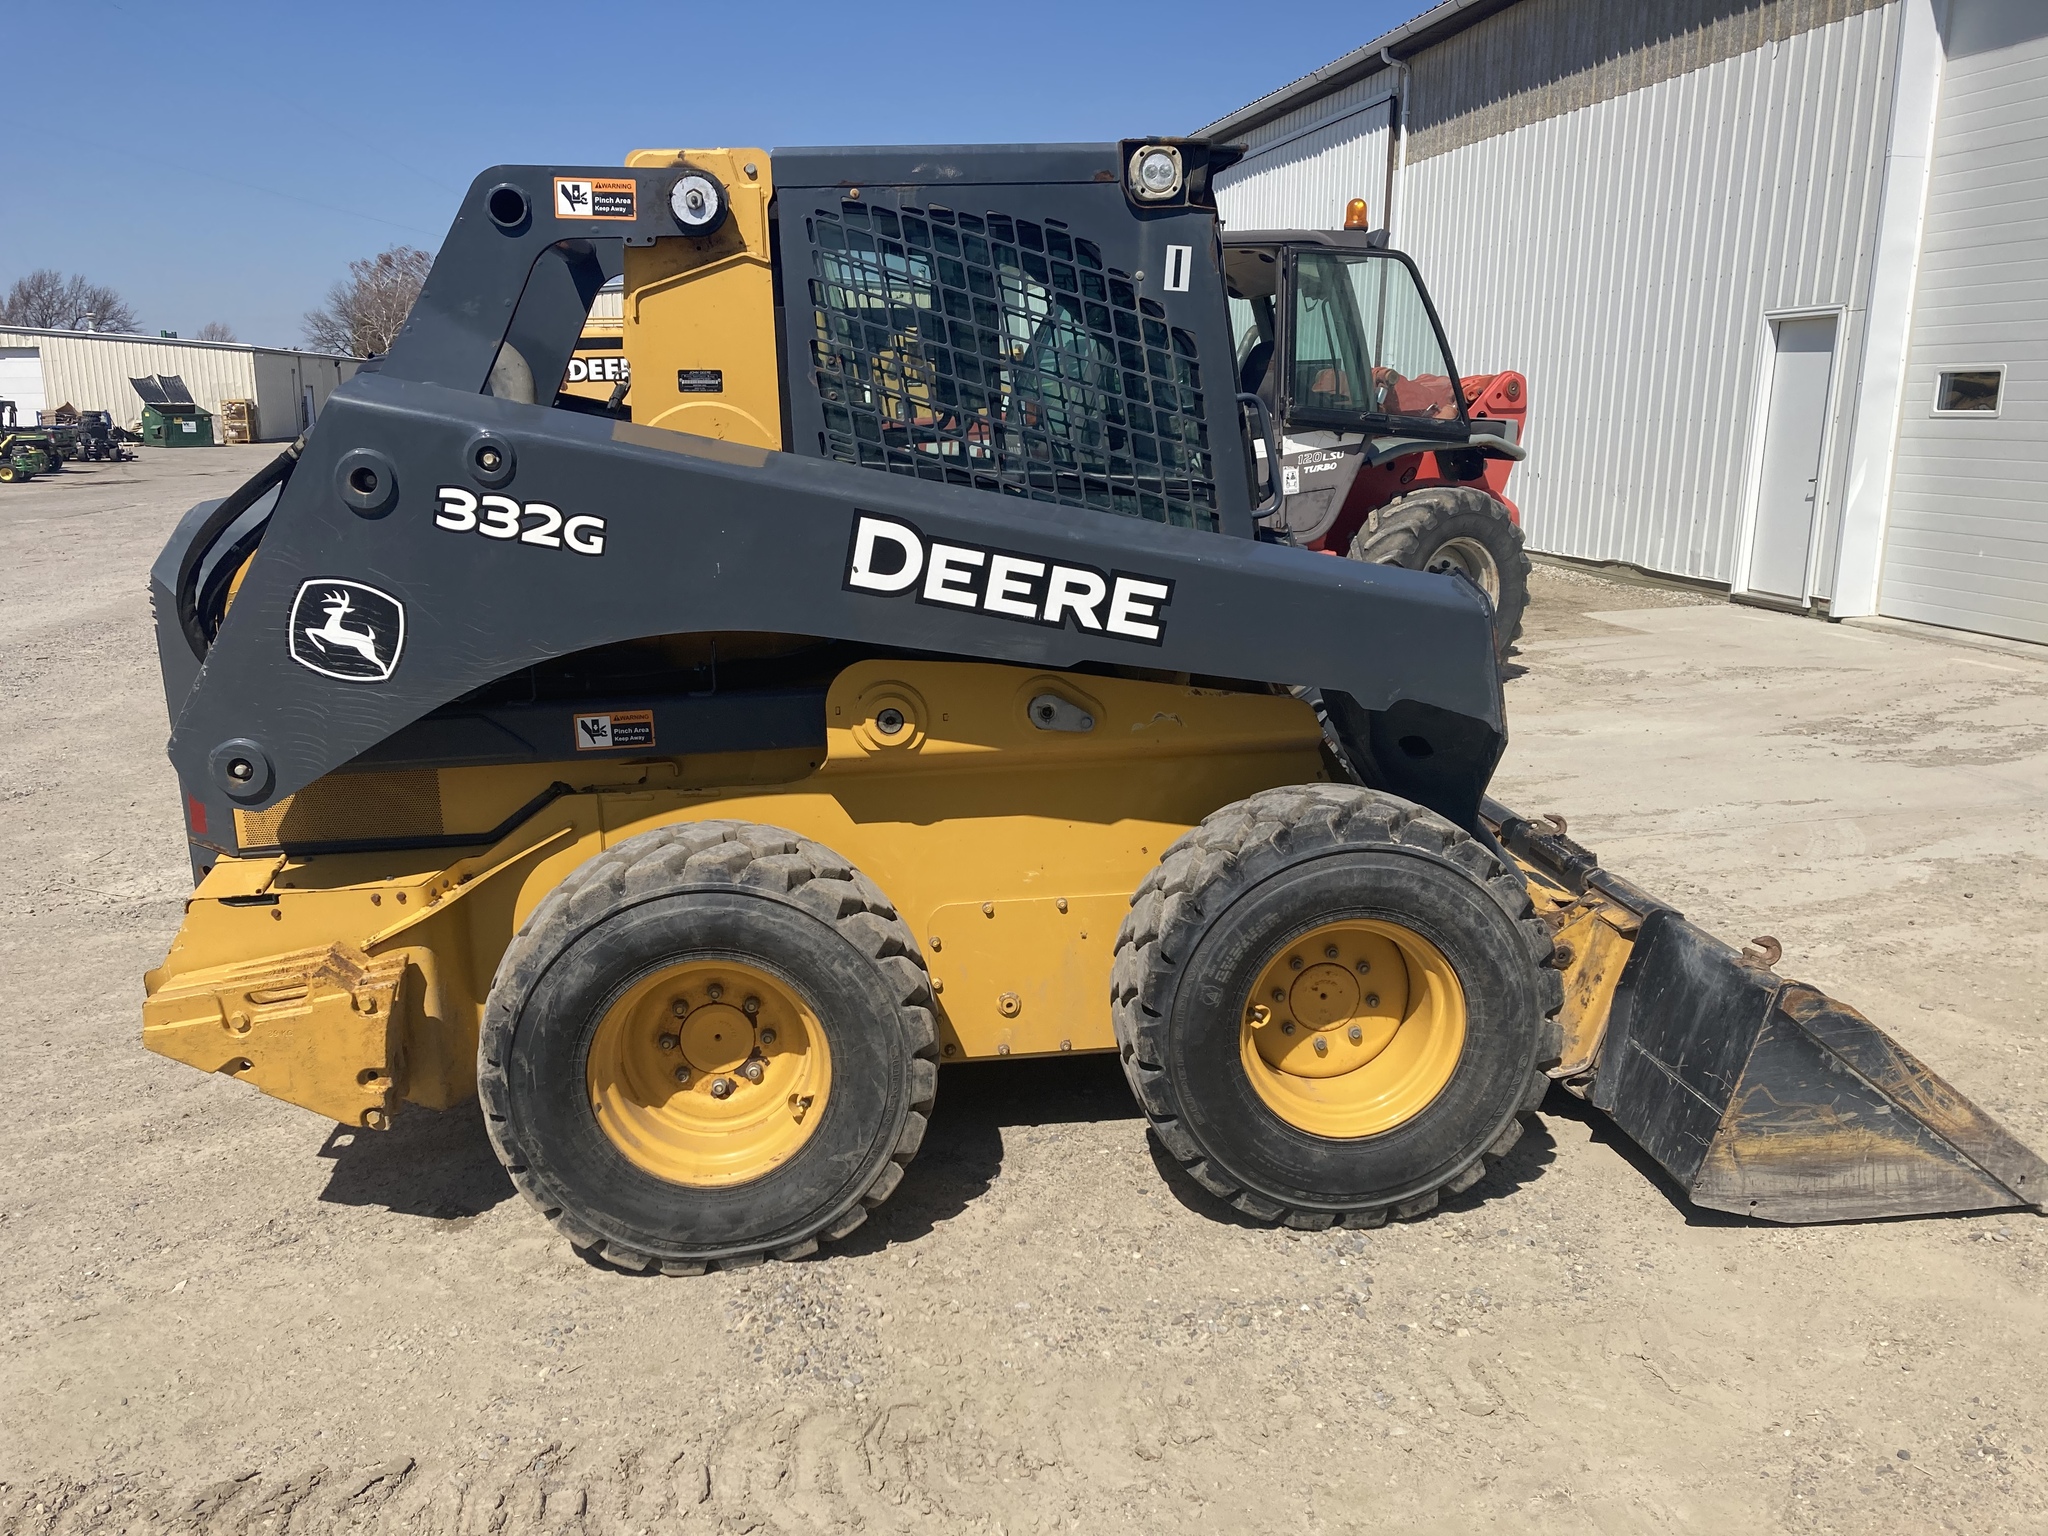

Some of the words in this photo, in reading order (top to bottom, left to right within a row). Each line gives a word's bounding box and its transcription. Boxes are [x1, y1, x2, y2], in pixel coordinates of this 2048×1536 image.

[600, 182, 632, 190] WARNING
[594, 196, 614, 204] Pinch
[610, 205, 626, 213] Away
[1297, 451, 1322, 465] 120
[1322, 450, 1345, 462] LSU
[1303, 462, 1337, 474] TURBO
[435, 487, 606, 556] 332G
[849, 516, 1169, 640] DEERE
